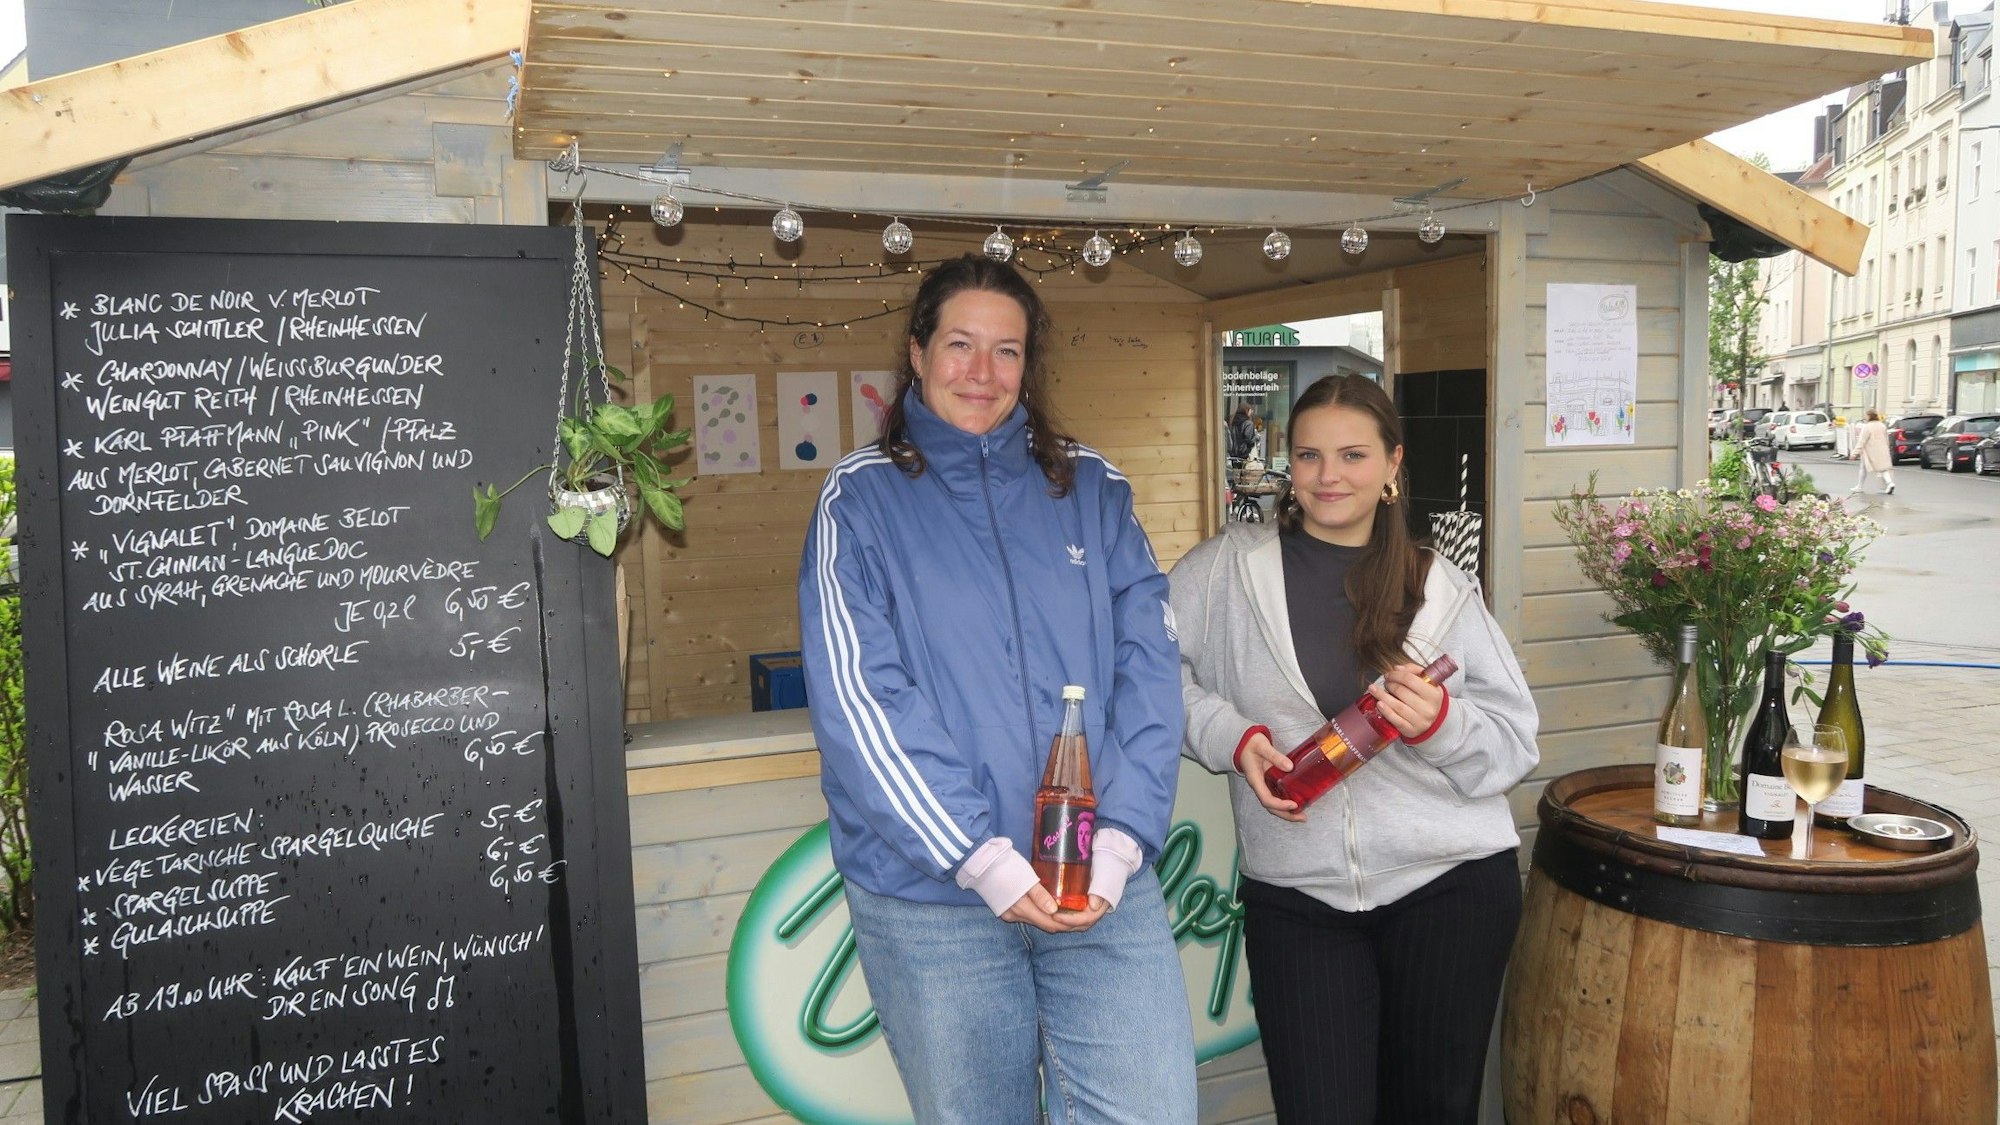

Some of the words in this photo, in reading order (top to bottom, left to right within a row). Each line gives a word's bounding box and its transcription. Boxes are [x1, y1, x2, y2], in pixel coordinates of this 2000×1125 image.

[89, 292, 163, 316] BLANC
[170, 292, 204, 313] DE
[210, 289, 261, 314] NOIR
[292, 286, 381, 319] MERLOT
[84, 320, 161, 357] JULIA
[165, 317, 269, 344] SCHITTLER
[85, 385, 187, 422] WEINGUT
[194, 384, 258, 418] REITH
[94, 427, 153, 456] KARL
[159, 419, 284, 454] PFAFFMANN
[66, 466, 110, 492] AUS
[117, 459, 199, 493] MERLOT,
[203, 453, 313, 480] CABERNET
[313, 444, 426, 476] SAUVIGNON
[432, 448, 473, 470] UND
[88, 478, 249, 516] DORNFELDER
[243, 512, 331, 545] DOMAINE
[338, 506, 411, 529] BELOT
[81, 587, 128, 613] AUS
[134, 579, 207, 611] SYRAH,
[211, 569, 315, 598] GRENACHE
[317, 568, 355, 590] UND
[359, 557, 480, 592] MOURVÈDRE
[334, 599, 371, 633] JE
[92, 665, 147, 694] ALLE
[157, 651, 225, 686] WEINE
[226, 648, 270, 676] ALS
[274, 640, 370, 672] SCHORLE
[246, 706, 277, 734] MIT
[255, 732, 293, 754] AUS
[364, 717, 455, 749] PROSECCO
[459, 711, 500, 734] UND
[108, 770, 201, 802] WASSER
[95, 842, 258, 889] VEGETARISCHE
[110, 889, 291, 960] GULASCHSUPPE
[102, 992, 141, 1022] AB
[144, 982, 204, 1012] 19.00
[343, 951, 383, 979] EIN
[262, 991, 307, 1021] DIR
[309, 983, 348, 1012] EIN
[351, 971, 420, 1014] SONG
[126, 1074, 189, 1118] VIEL
[197, 1060, 274, 1105] SPASS
[279, 1054, 335, 1085] UND
